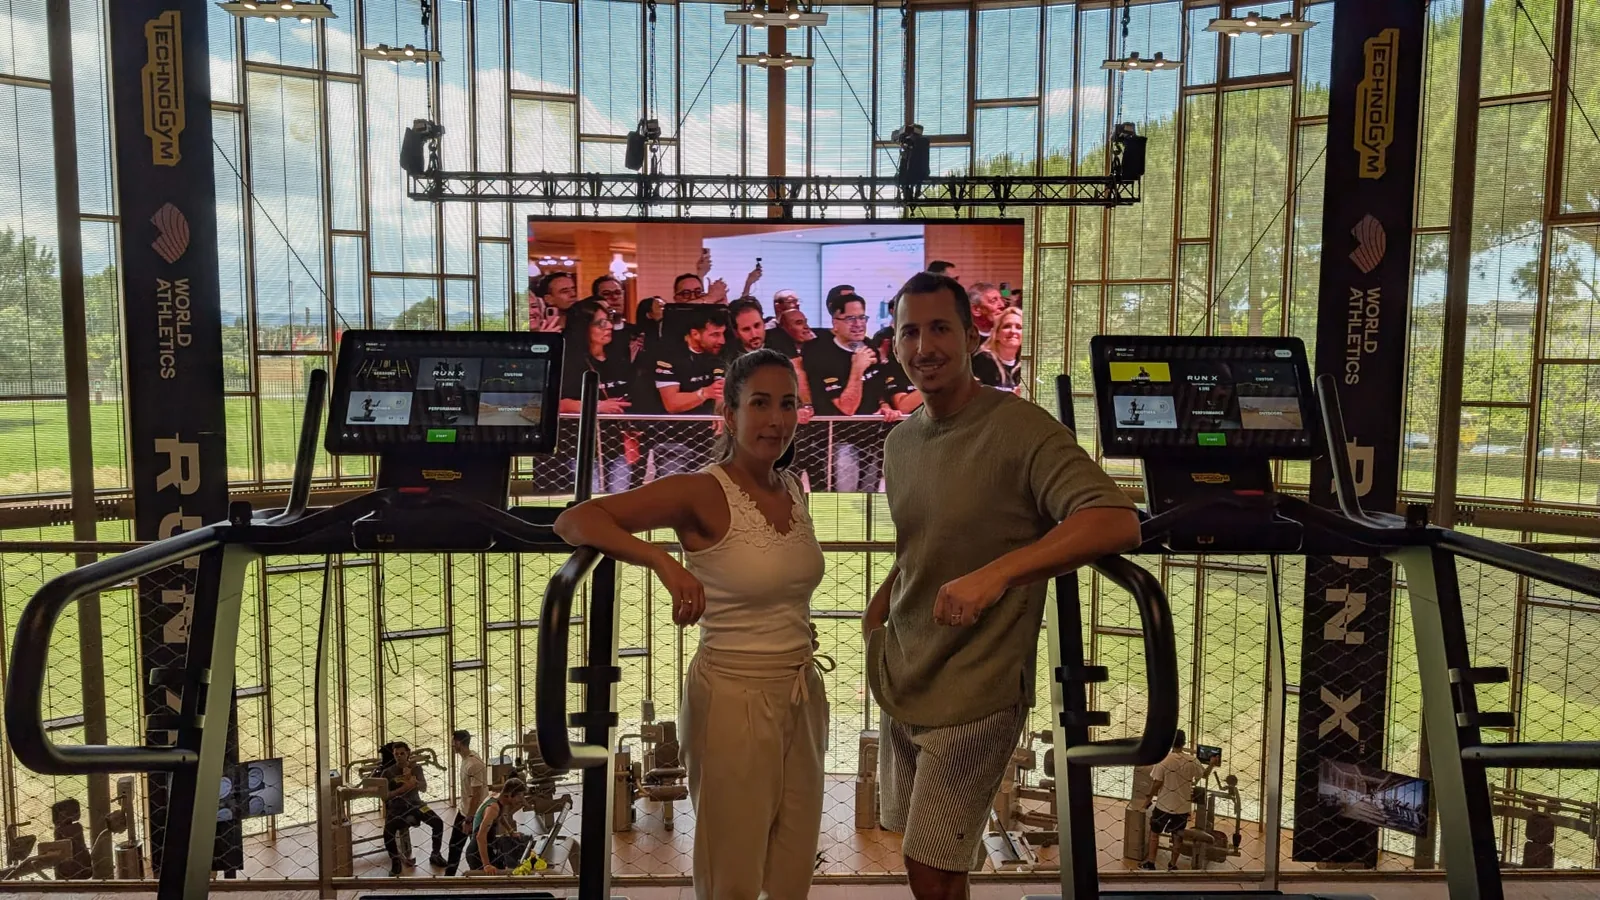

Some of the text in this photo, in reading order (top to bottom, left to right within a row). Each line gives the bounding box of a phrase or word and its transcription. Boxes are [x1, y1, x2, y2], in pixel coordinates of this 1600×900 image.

[148, 13, 178, 161] TECHNOGYM
[1360, 31, 1395, 174] TECHNOGYM
[156, 278, 176, 380] ATHLETICS
[174, 278, 192, 348] WORLD
[1345, 286, 1364, 386] ATHLETICS
[1363, 286, 1381, 354] WORLD
